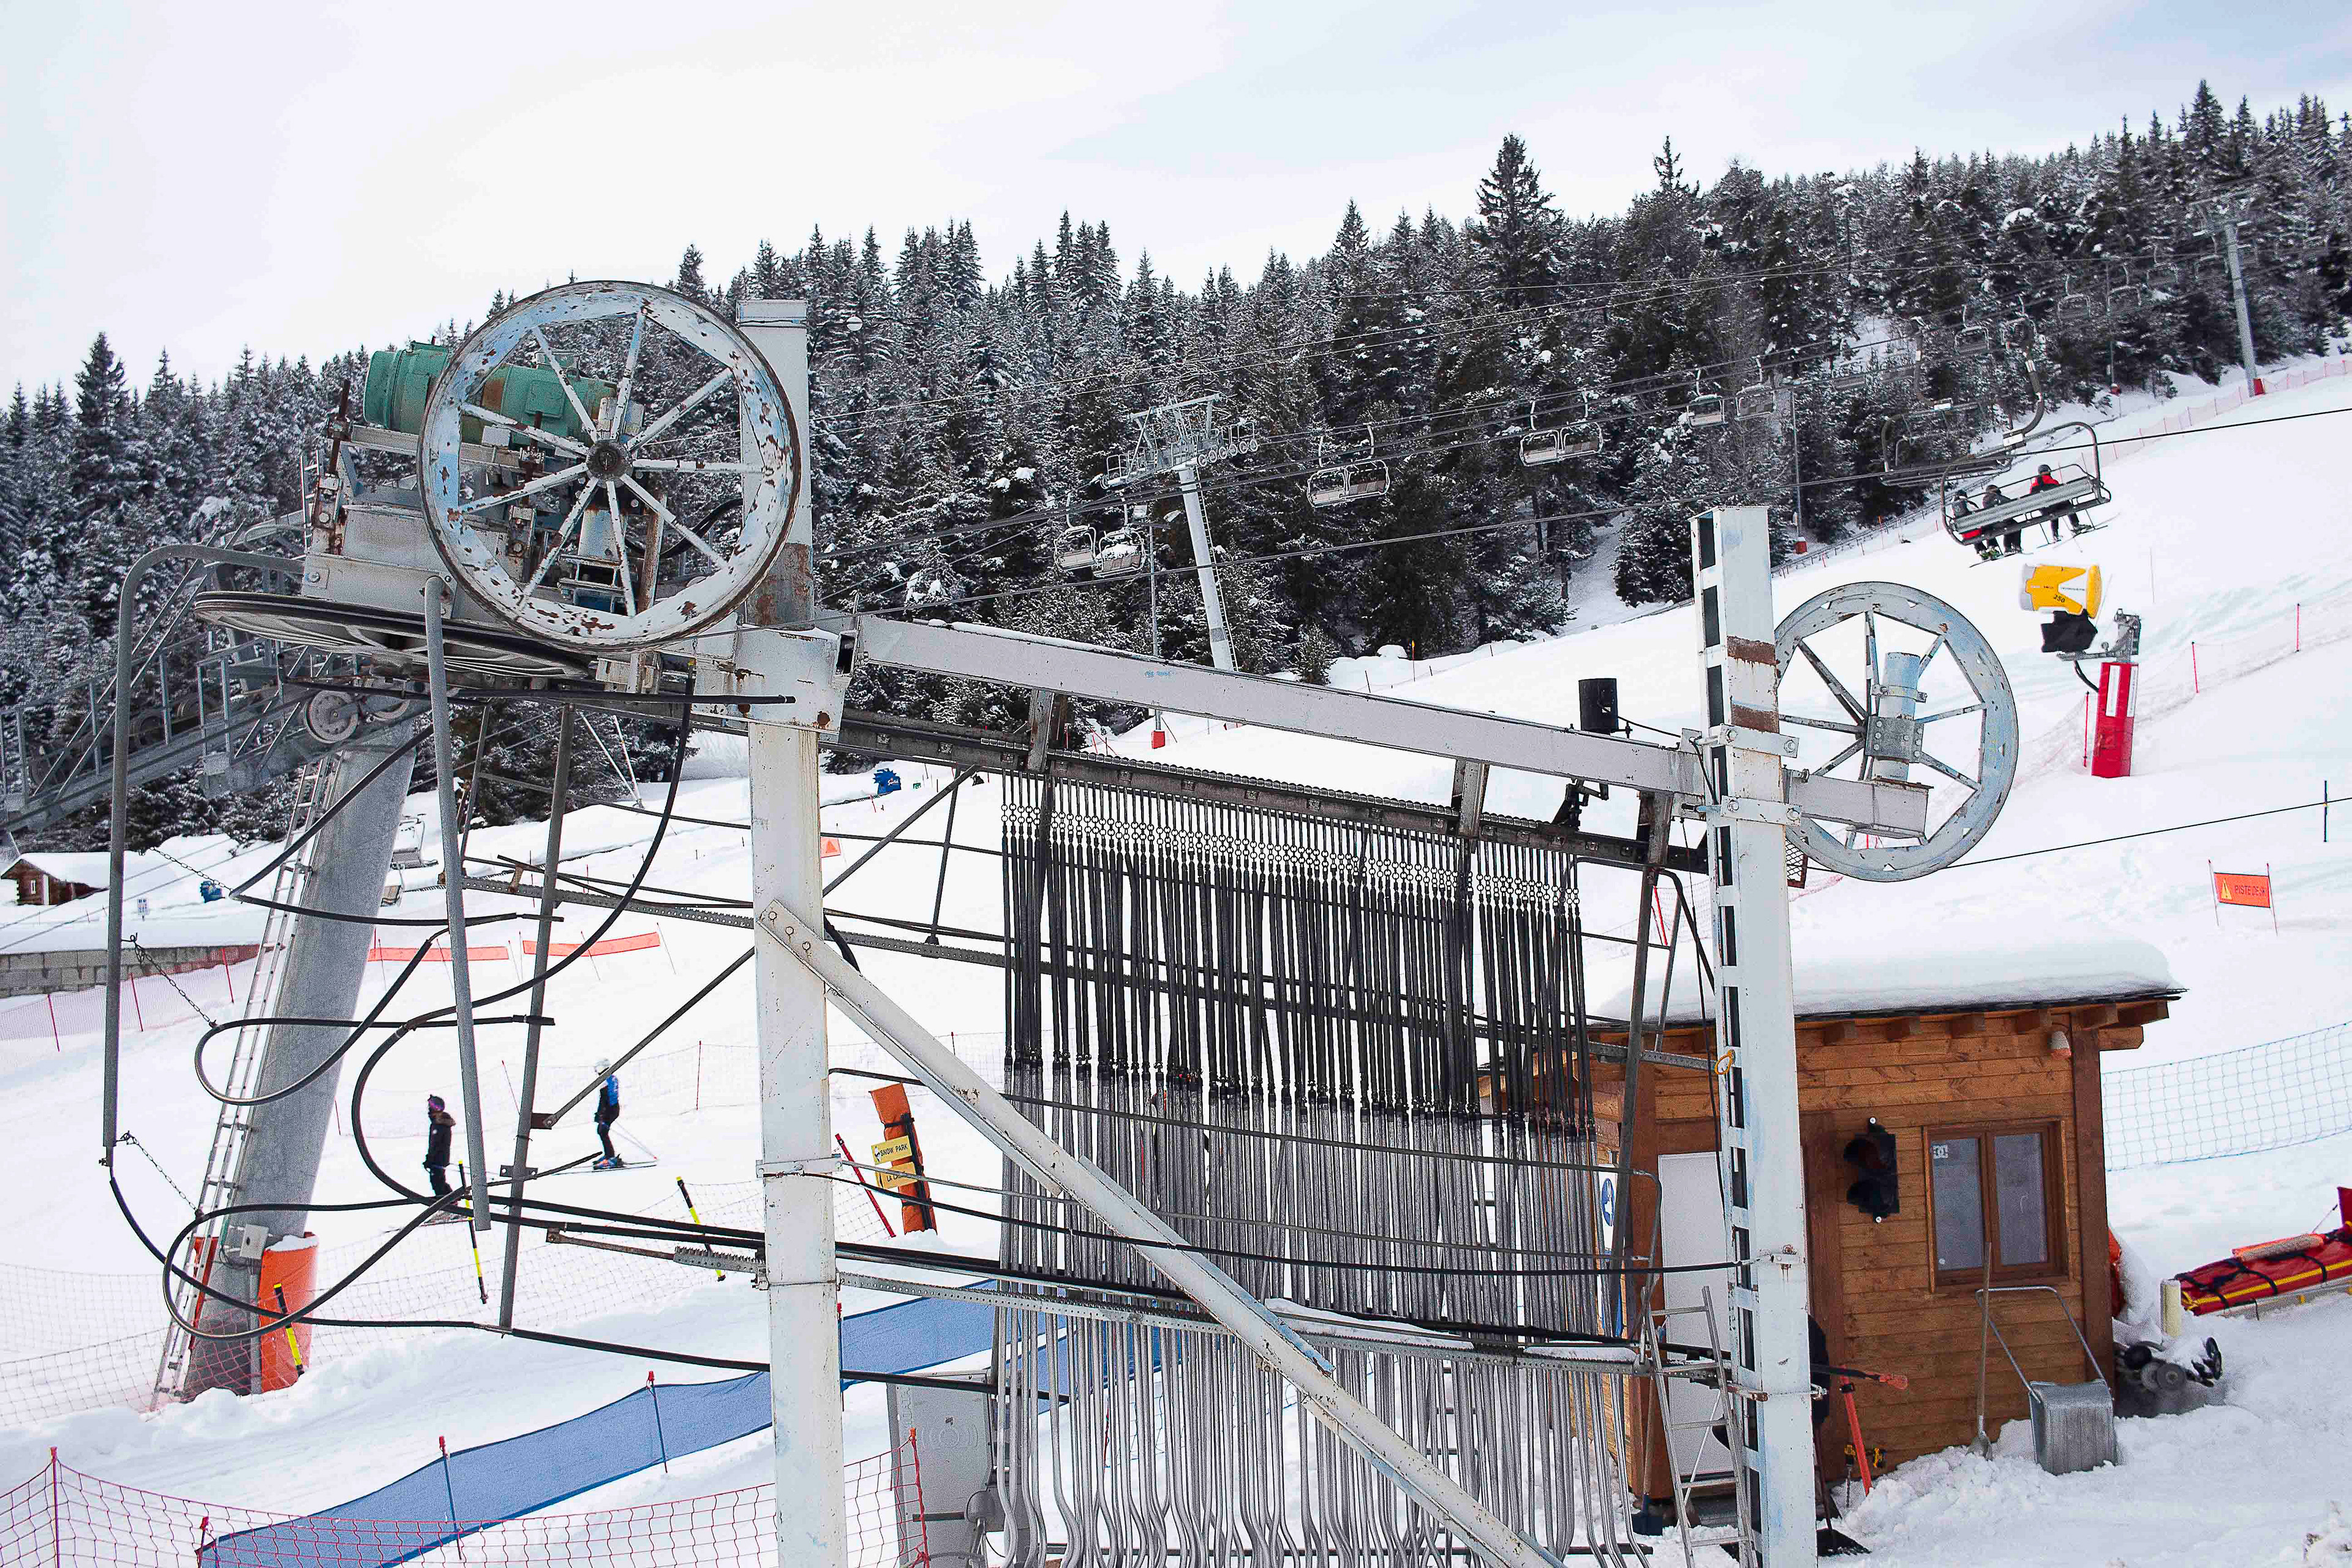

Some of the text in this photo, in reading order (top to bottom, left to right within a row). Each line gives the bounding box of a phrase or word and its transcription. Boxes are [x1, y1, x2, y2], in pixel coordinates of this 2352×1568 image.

[2053, 594, 2065, 603] 250
[2234, 885, 2251, 895] PISTE
[880, 1144, 908, 1156] SNOW PARK
